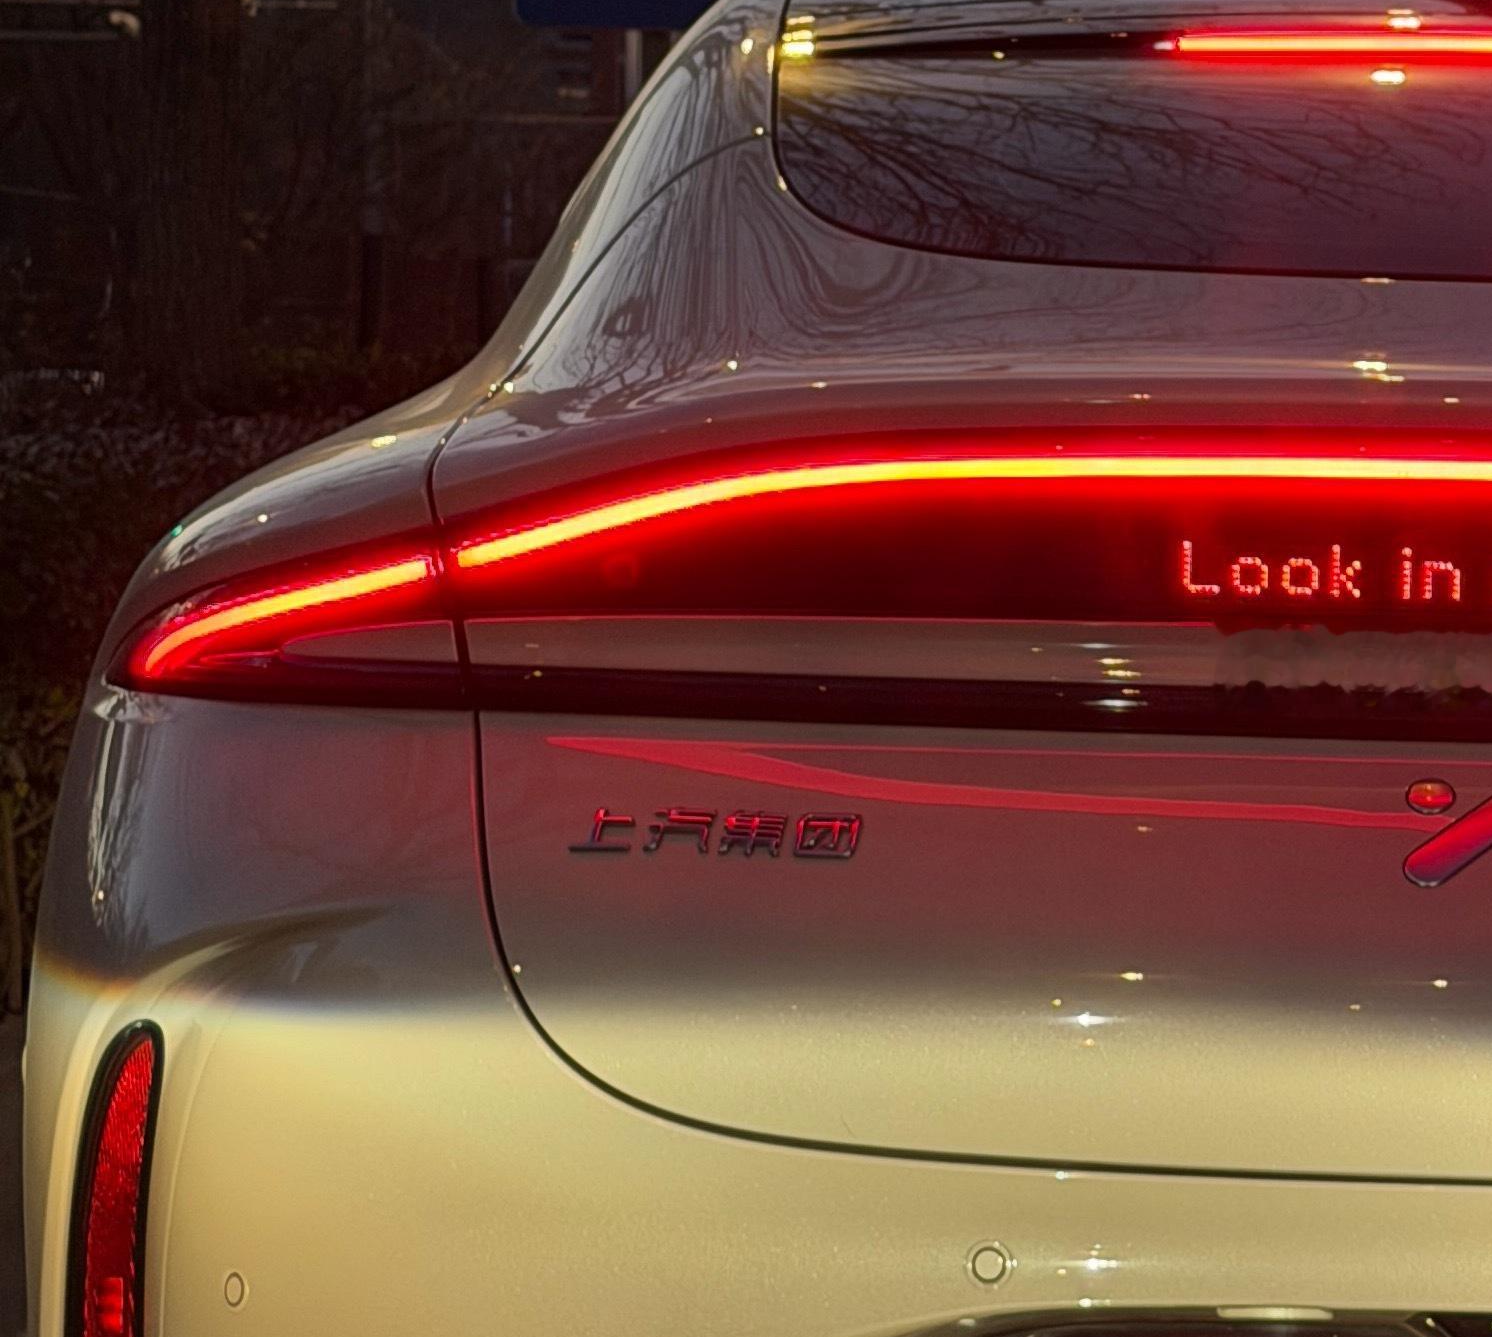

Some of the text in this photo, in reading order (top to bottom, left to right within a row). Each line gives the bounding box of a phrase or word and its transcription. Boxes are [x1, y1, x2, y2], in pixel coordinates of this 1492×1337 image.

[1182, 539, 1362, 598] Look
[1401, 546, 1461, 602] in
[568, 807, 865, 858] 上汽集团
